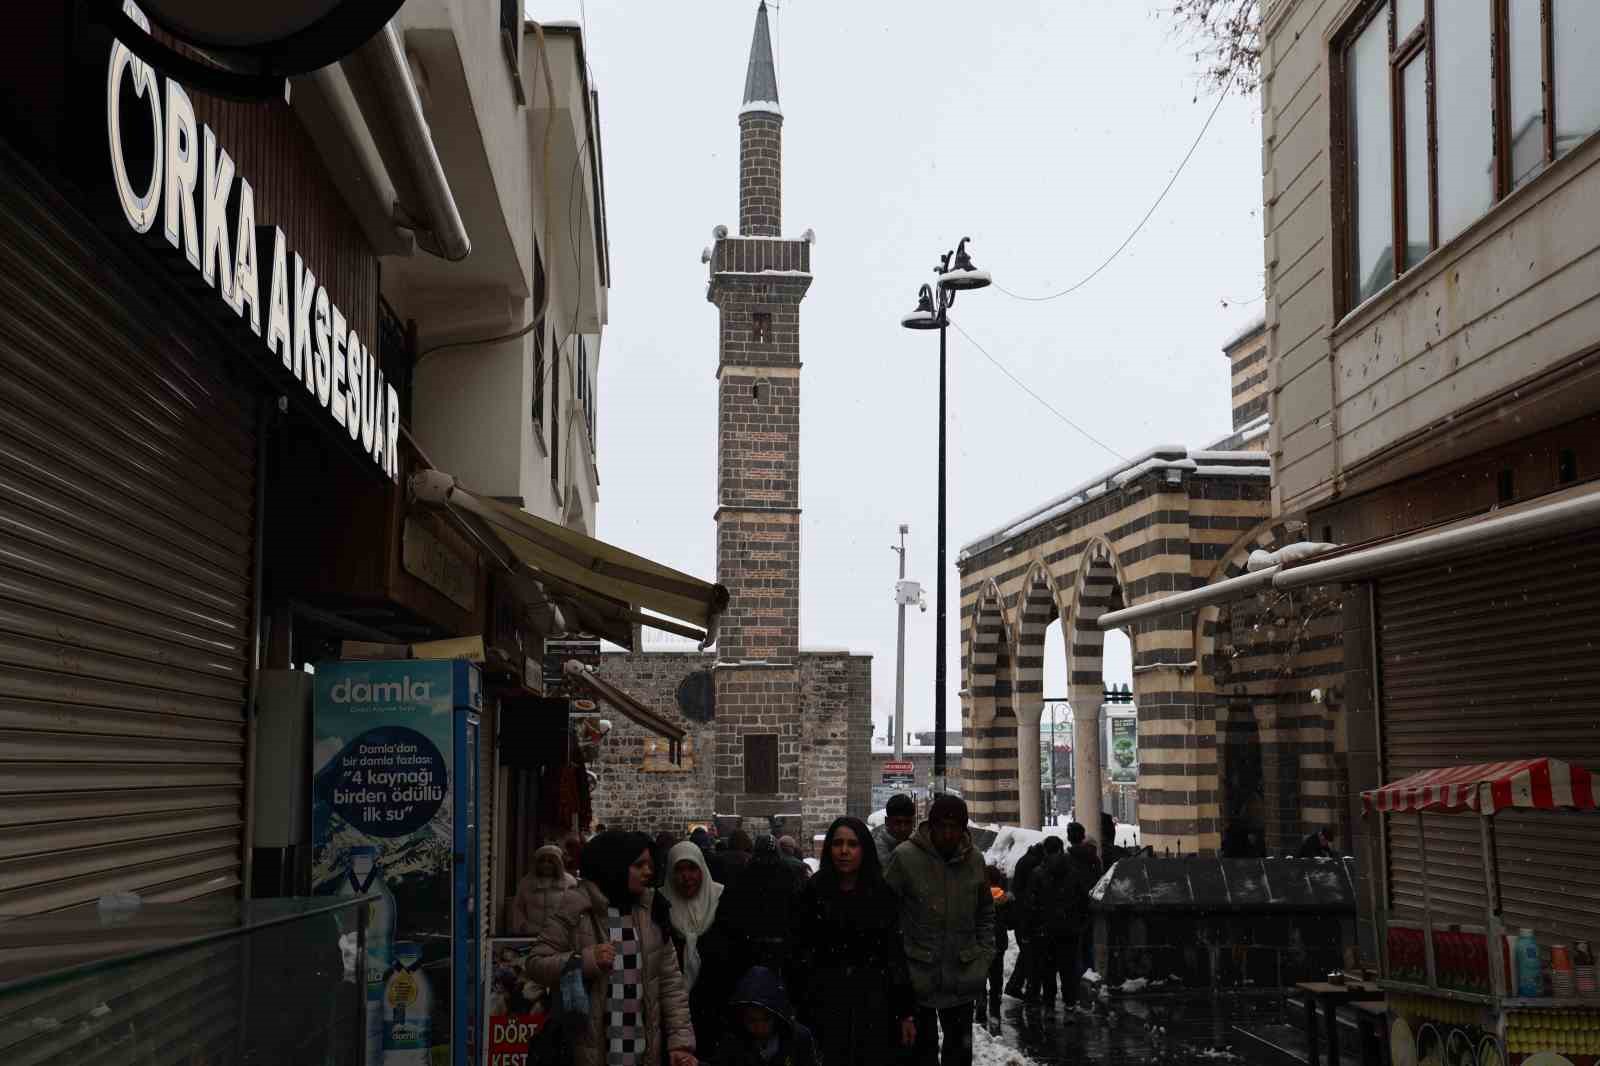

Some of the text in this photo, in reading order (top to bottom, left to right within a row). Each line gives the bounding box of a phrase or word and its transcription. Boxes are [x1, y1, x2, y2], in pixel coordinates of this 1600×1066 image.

[267, 225, 399, 485] AKSESUAR
[330, 675, 432, 704] damla
[359, 744, 417, 754] Damla'dan
[343, 756, 356, 766] bir
[360, 755, 394, 766] damla
[367, 768, 433, 787] kaynağı
[333, 786, 442, 804] birden ödüllü
[362, 806, 381, 822] ilk
[494, 1018, 538, 1043] DÖRT
